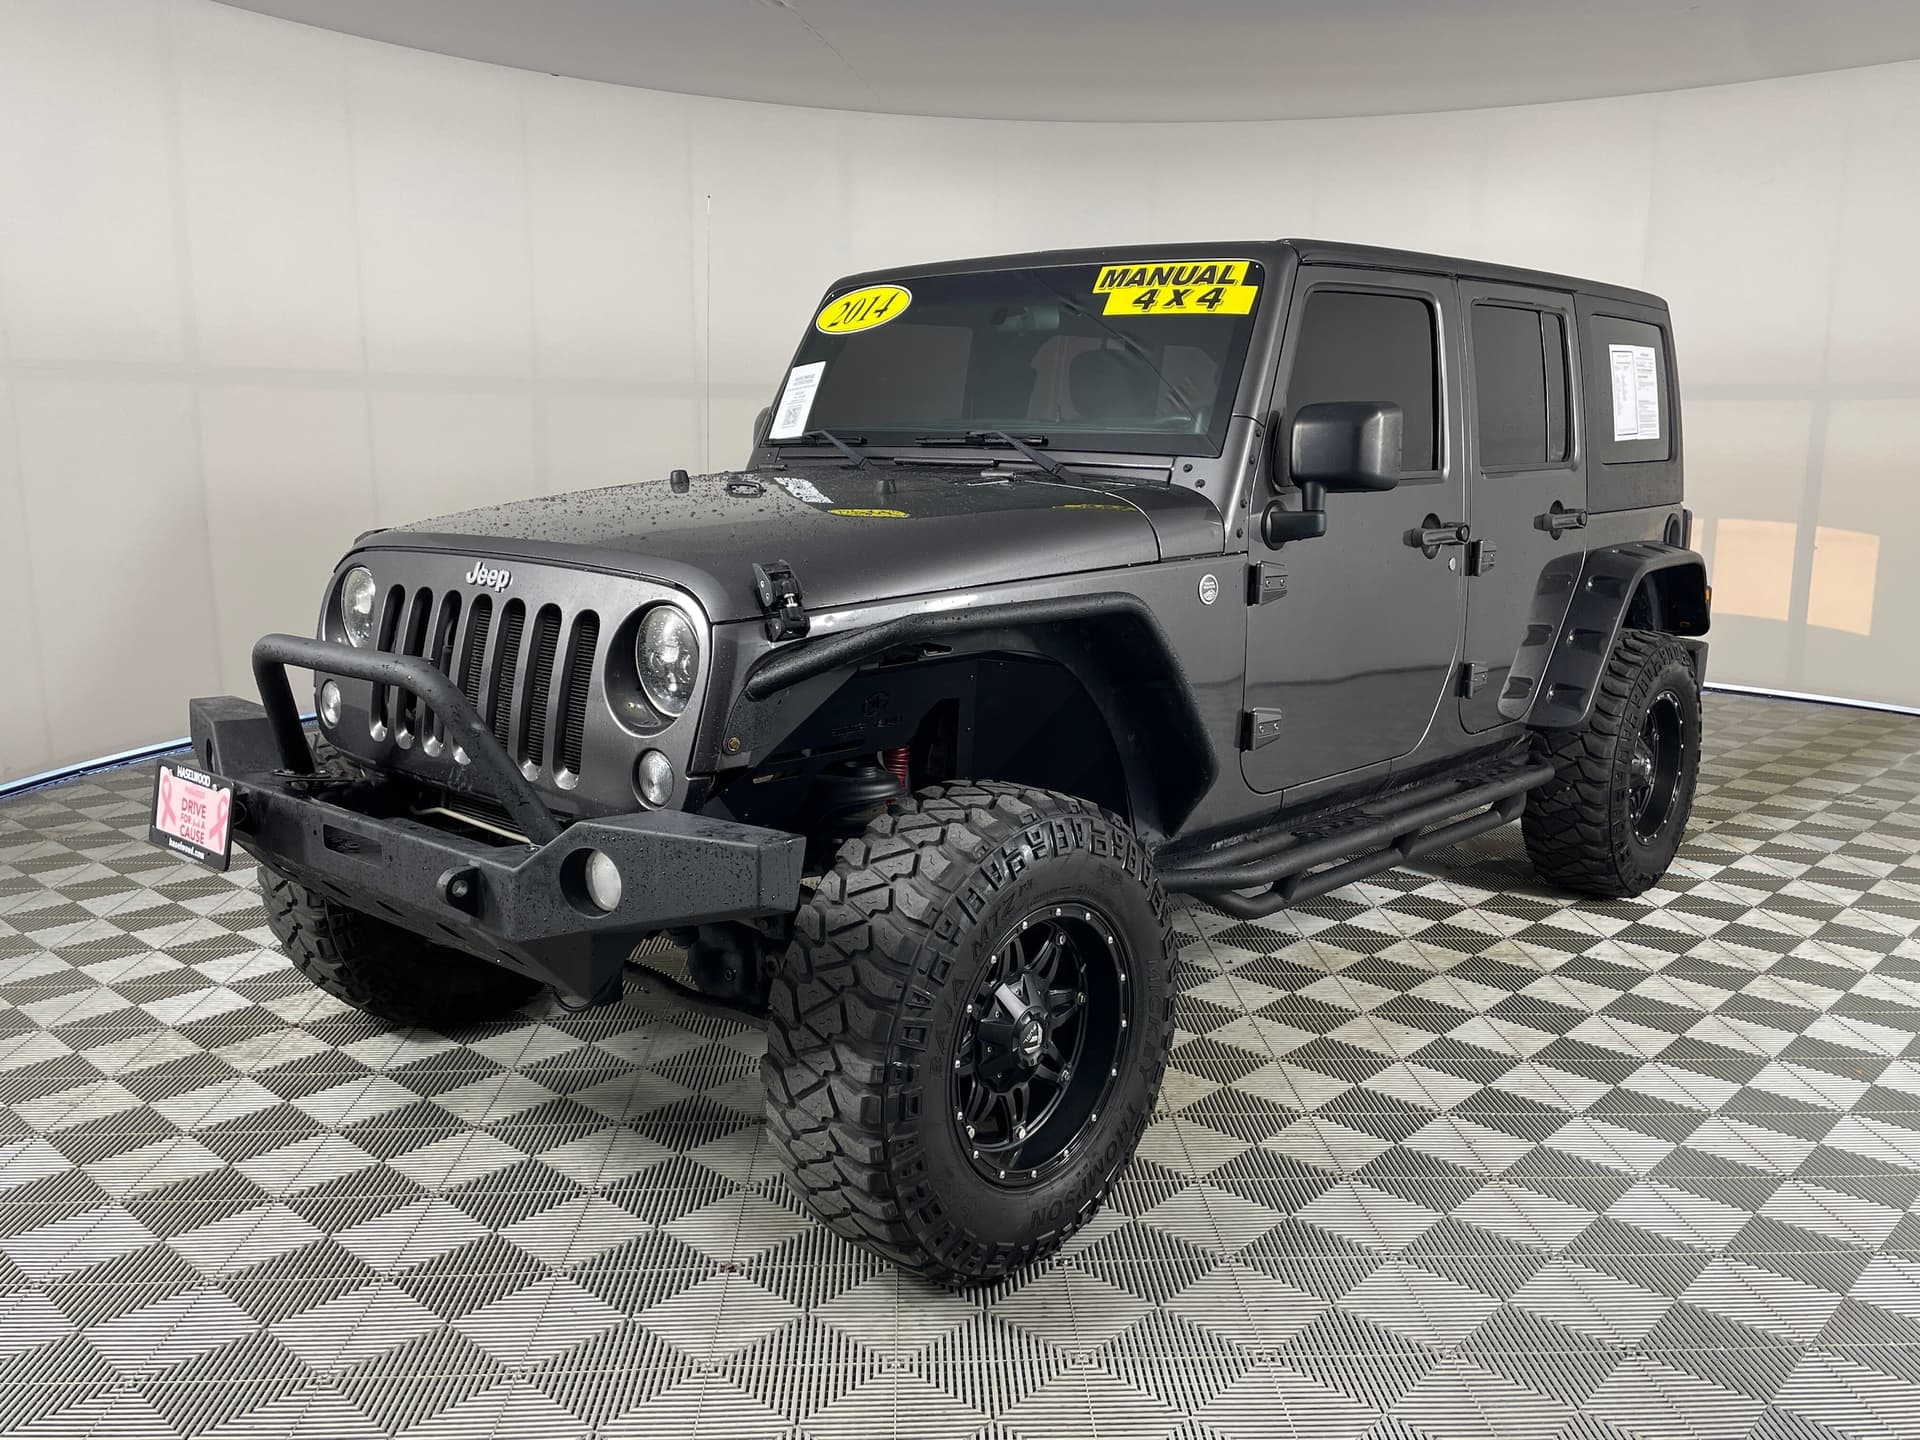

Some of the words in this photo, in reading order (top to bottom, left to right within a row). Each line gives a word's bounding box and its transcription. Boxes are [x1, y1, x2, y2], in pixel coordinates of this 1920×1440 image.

[1099, 264, 1237, 289] MANUAL
[827, 291, 900, 328] 2014
[466, 561, 513, 593] Jeep
[177, 765, 210, 786] HASELWOOD
[182, 798, 206, 819] DRIVE
[180, 825, 205, 844] CAUSE
[971, 892, 1015, 959] MTZ
